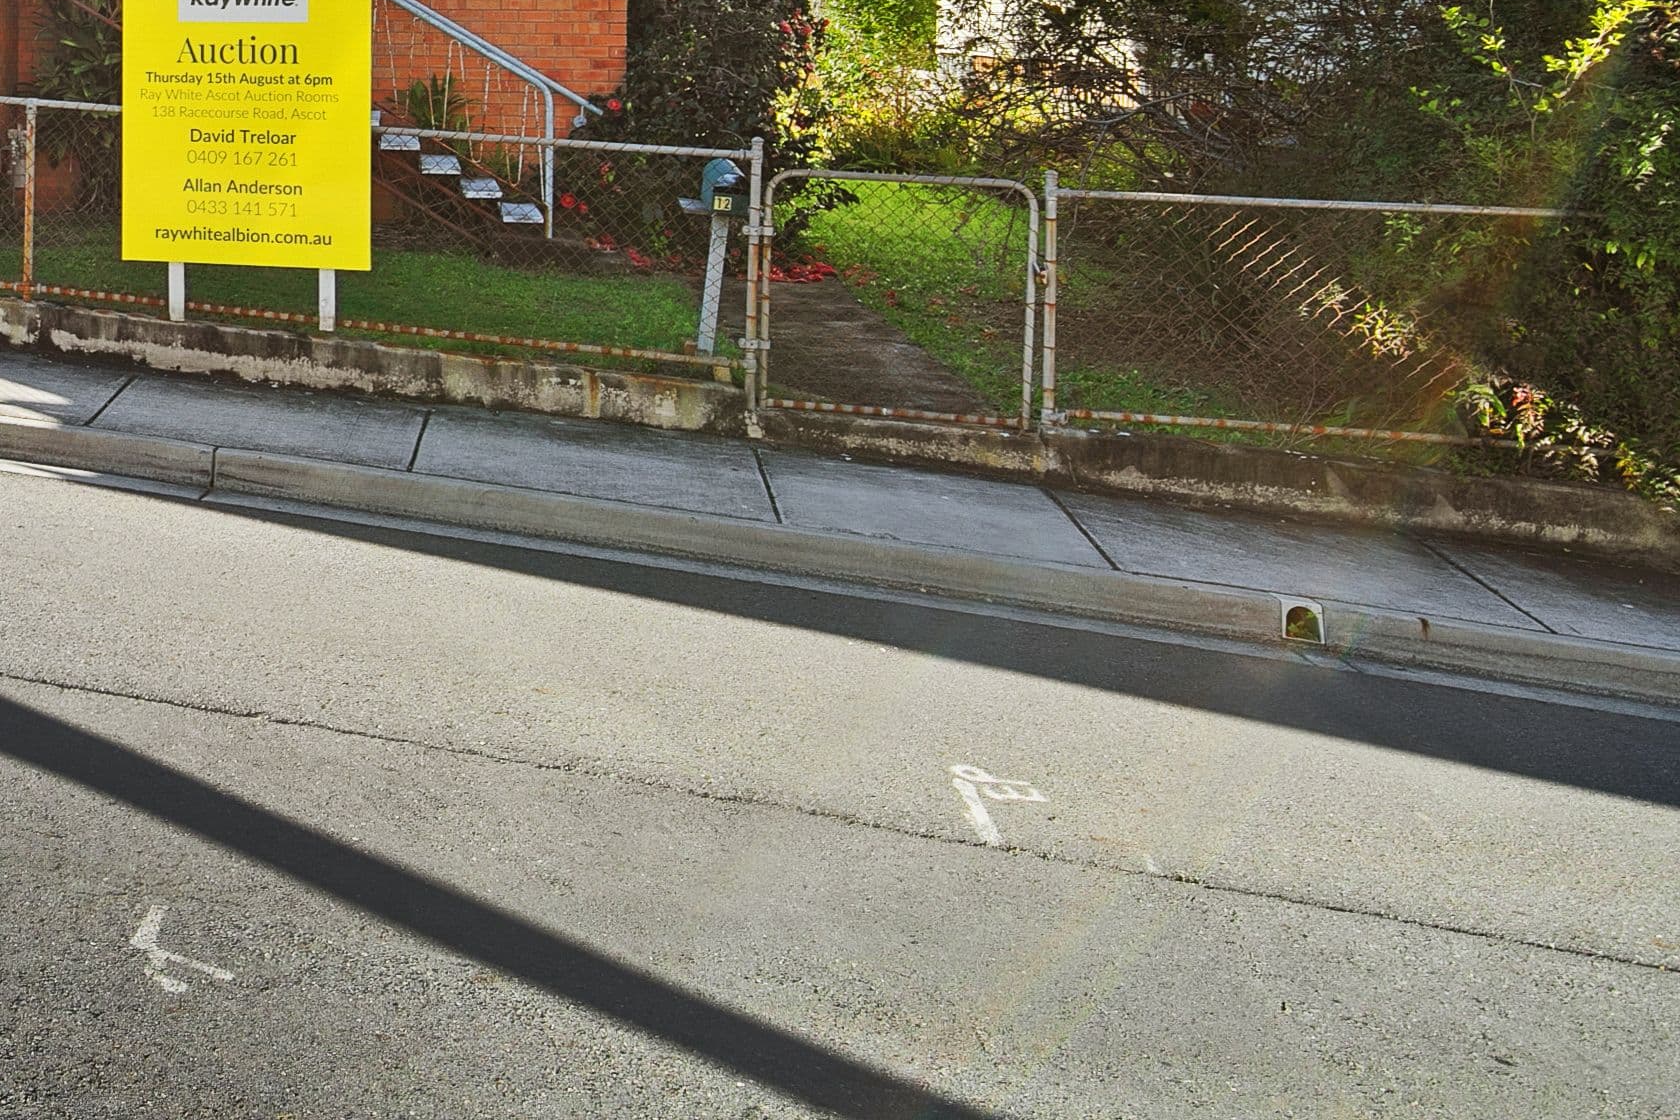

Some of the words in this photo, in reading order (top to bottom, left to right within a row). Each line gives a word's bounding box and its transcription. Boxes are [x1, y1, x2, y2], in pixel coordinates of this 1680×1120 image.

[177, 36, 299, 64] Auction
[145, 72, 204, 85] Thursday
[207, 72, 236, 84] 15th
[239, 73, 285, 87] August
[288, 75, 301, 85] at
[304, 74, 333, 87] 6pm
[140, 88, 162, 102] Ray
[165, 88, 204, 101] White
[206, 88, 241, 101] Ascot
[244, 89, 294, 103] Auction
[296, 89, 340, 104] Rooms
[152, 106, 177, 119] 138
[179, 105, 250, 120] Racecourse
[290, 108, 328, 120] Ascot
[191, 129, 235, 143] David
[240, 130, 297, 144] Treloar
[186, 150, 228, 165] 0409
[234, 152, 264, 165] 167
[268, 152, 297, 166] 261
[183, 178, 222, 192] Allan
[227, 180, 303, 195] Anderson
[187, 200, 228, 215] 0433
[234, 201, 262, 216] 141
[267, 202, 297, 217] 571
[717, 198, 731, 210] 12
[156, 226, 332, 245] raywhitealbion.com.au
